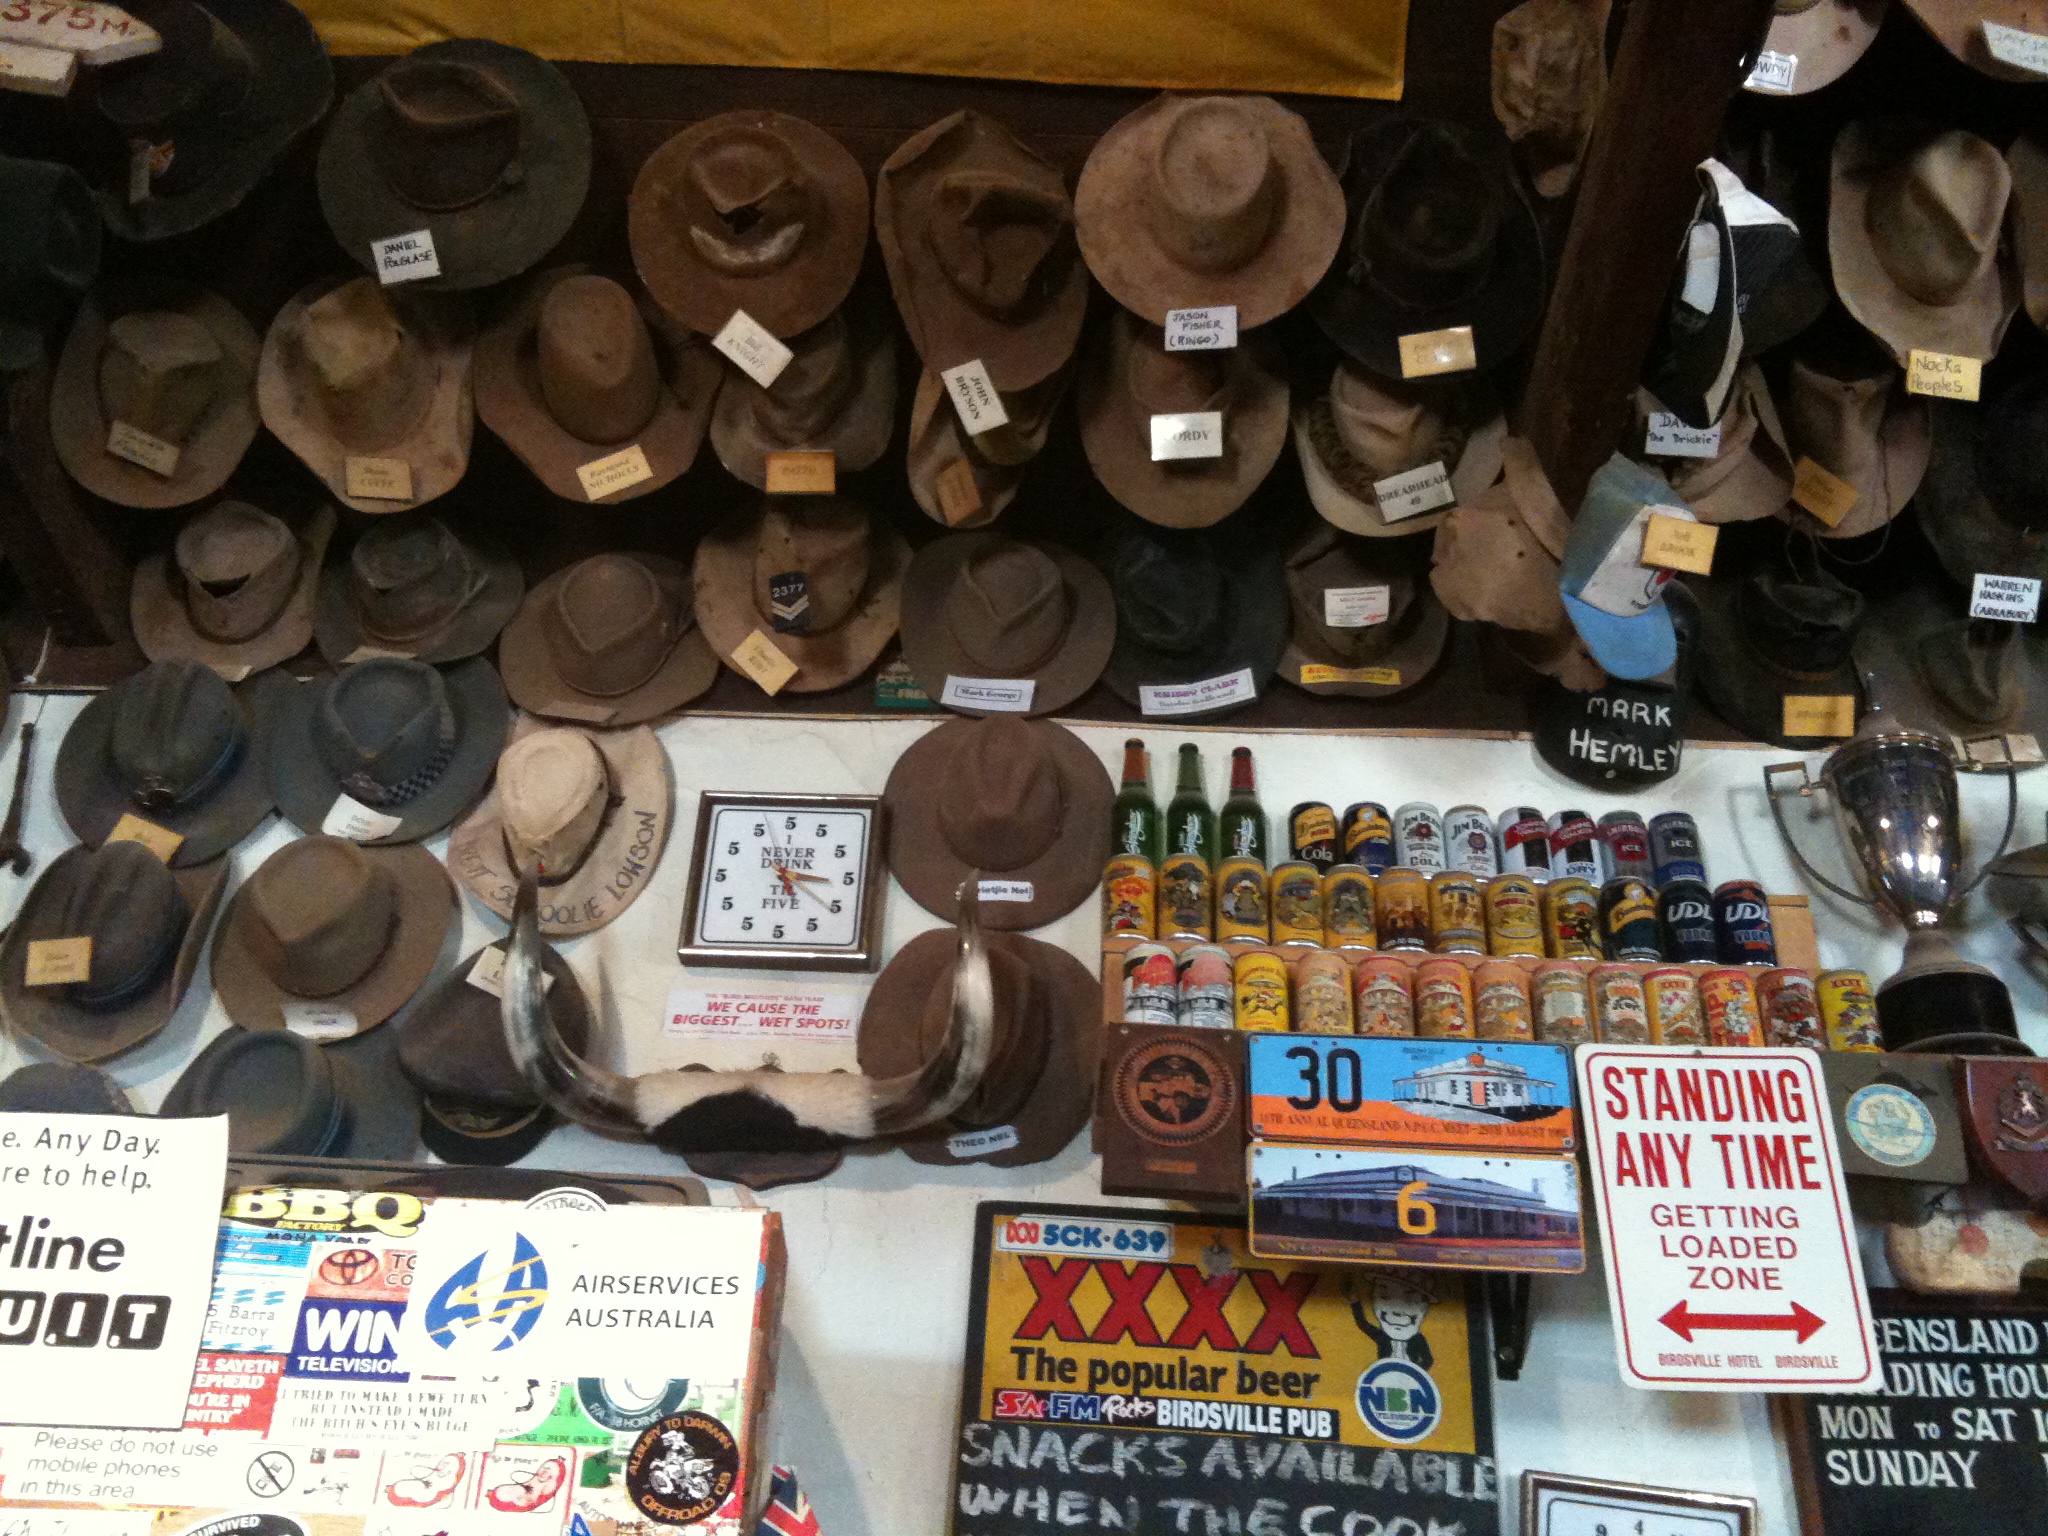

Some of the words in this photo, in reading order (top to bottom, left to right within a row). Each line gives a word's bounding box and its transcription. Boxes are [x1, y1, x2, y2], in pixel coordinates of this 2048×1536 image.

[384, 240, 421, 255] DANIEL
[1172, 311, 1209, 322] JASON
[1182, 320, 1224, 332] FISHER
[1169, 334, 1219, 347] (RINGO)
[955, 376, 980, 420] BRYSON
[970, 376, 990, 406] JOHN
[772, 583, 804, 598] 2377
[1984, 578, 2034, 594] WARREN
[1587, 697, 1672, 727] MARK
[1569, 728, 1682, 772] HEMLEY
[754, 823, 765, 837] 5
[785, 816, 797, 830] 5
[816, 824, 827, 838] 5
[728, 842, 740, 855] 5
[834, 845, 846, 858] 5
[1621, 843, 1643, 853] ICE
[1670, 839, 1693, 849] ICE
[604, 810, 657, 900] LOWSON
[761, 847, 815, 859] NEVER
[1302, 845, 1334, 862] Cola
[761, 858, 813, 870] DRINK
[1566, 866, 1598, 876] DRY
[715, 868, 726, 882] 5
[843, 872, 854, 886] 5
[722, 897, 733, 911] 5
[762, 899, 800, 910] FIVE
[830, 900, 842, 914] 5
[1725, 902, 1771, 922] UDL
[742, 917, 753, 931] 5
[773, 925, 784, 939] 5
[807, 917, 818, 932] 5
[707, 1002, 732, 1012] WE
[736, 1002, 786, 1014] CAUSE
[793, 1004, 821, 1015] THE
[759, 1017, 793, 1027] WET
[796, 1018, 851, 1030] SPOTS!
[1285, 1047, 1363, 1112] 30
[1603, 1066, 1807, 1124] STANDING
[35, 1127, 92, 1157] Any
[103, 1129, 160, 1160] Day.
[954, 1138, 985, 1147] THEO
[1616, 1132, 1691, 1188] ANY
[1712, 1134, 1822, 1190] TIME
[2, 1169, 30, 1185] re
[43, 1164, 70, 1186] to
[82, 1163, 153, 1194] help.
[222, 1187, 426, 1238] BBQ
[1398, 1181, 1437, 1235] 6
[1651, 1204, 1800, 1230] GETTING
[266, 1233, 317, 1244] MONA
[1660, 1235, 1798, 1260] LOADED
[571, 1274, 740, 1296] AIRSERVICES
[1689, 1266, 1783, 1291] ZONE
[229, 1305, 276, 1321] Barra
[1012, 1255, 1322, 1360] XXXX
[565, 1308, 715, 1329] AUSTRALIA
[306, 1308, 408, 1354] WIN
[214, 1358, 279, 1374] SAYETH
[1658, 1353, 1722, 1367] BIRDSVILLE
[1727, 1355, 1763, 1368] HOTEL
[1775, 1355, 1840, 1369] BIRDSVILLE
[1011, 1346, 1078, 1384] The
[1087, 1356, 1228, 1397] popular
[1236, 1359, 1321, 1399] beer
[232, 1394, 251, 1408] IN
[293, 1389, 334, 1401] TRIED
[340, 1390, 357, 1401] TO
[362, 1391, 399, 1403] MAKE
[1360, 1386, 1437, 1414] NBN
[343, 1404, 402, 1417] INSTEAD
[419, 1406, 453, 1418] MADE
[623, 1408, 663, 1429] HORNET
[1100, 1394, 1157, 1425] Rocks
[1156, 1398, 1284, 1435] BIRDSVILLE
[1287, 1408, 1332, 1438] PUB
[1816, 1404, 1895, 1440] MON
[1913, 1422, 1943, 1440] TO
[1951, 1406, 2018, 1442] SAT
[34, 1431, 103, 1454] Please
[110, 1433, 136, 1453] do
[140, 1437, 176, 1457] not
[182, 1441, 219, 1458] use
[27, 1456, 100, 1477] mobile
[103, 1459, 181, 1480] phones
[960, 1423, 1188, 1480] SNACKS
[1200, 1437, 1499, 1500] AVAILABLE
[1825, 1449, 1979, 1489] SUNDAY
[20, 1480, 38, 1494] in
[46, 1479, 82, 1496] this
[89, 1483, 135, 1498] area
[641, 1494, 716, 1521] OFFROAD
[958, 1481, 1139, 1533] WHEN
[1157, 1498, 1290, 1536] THE
[1299, 1505, 1466, 1536] COOK
